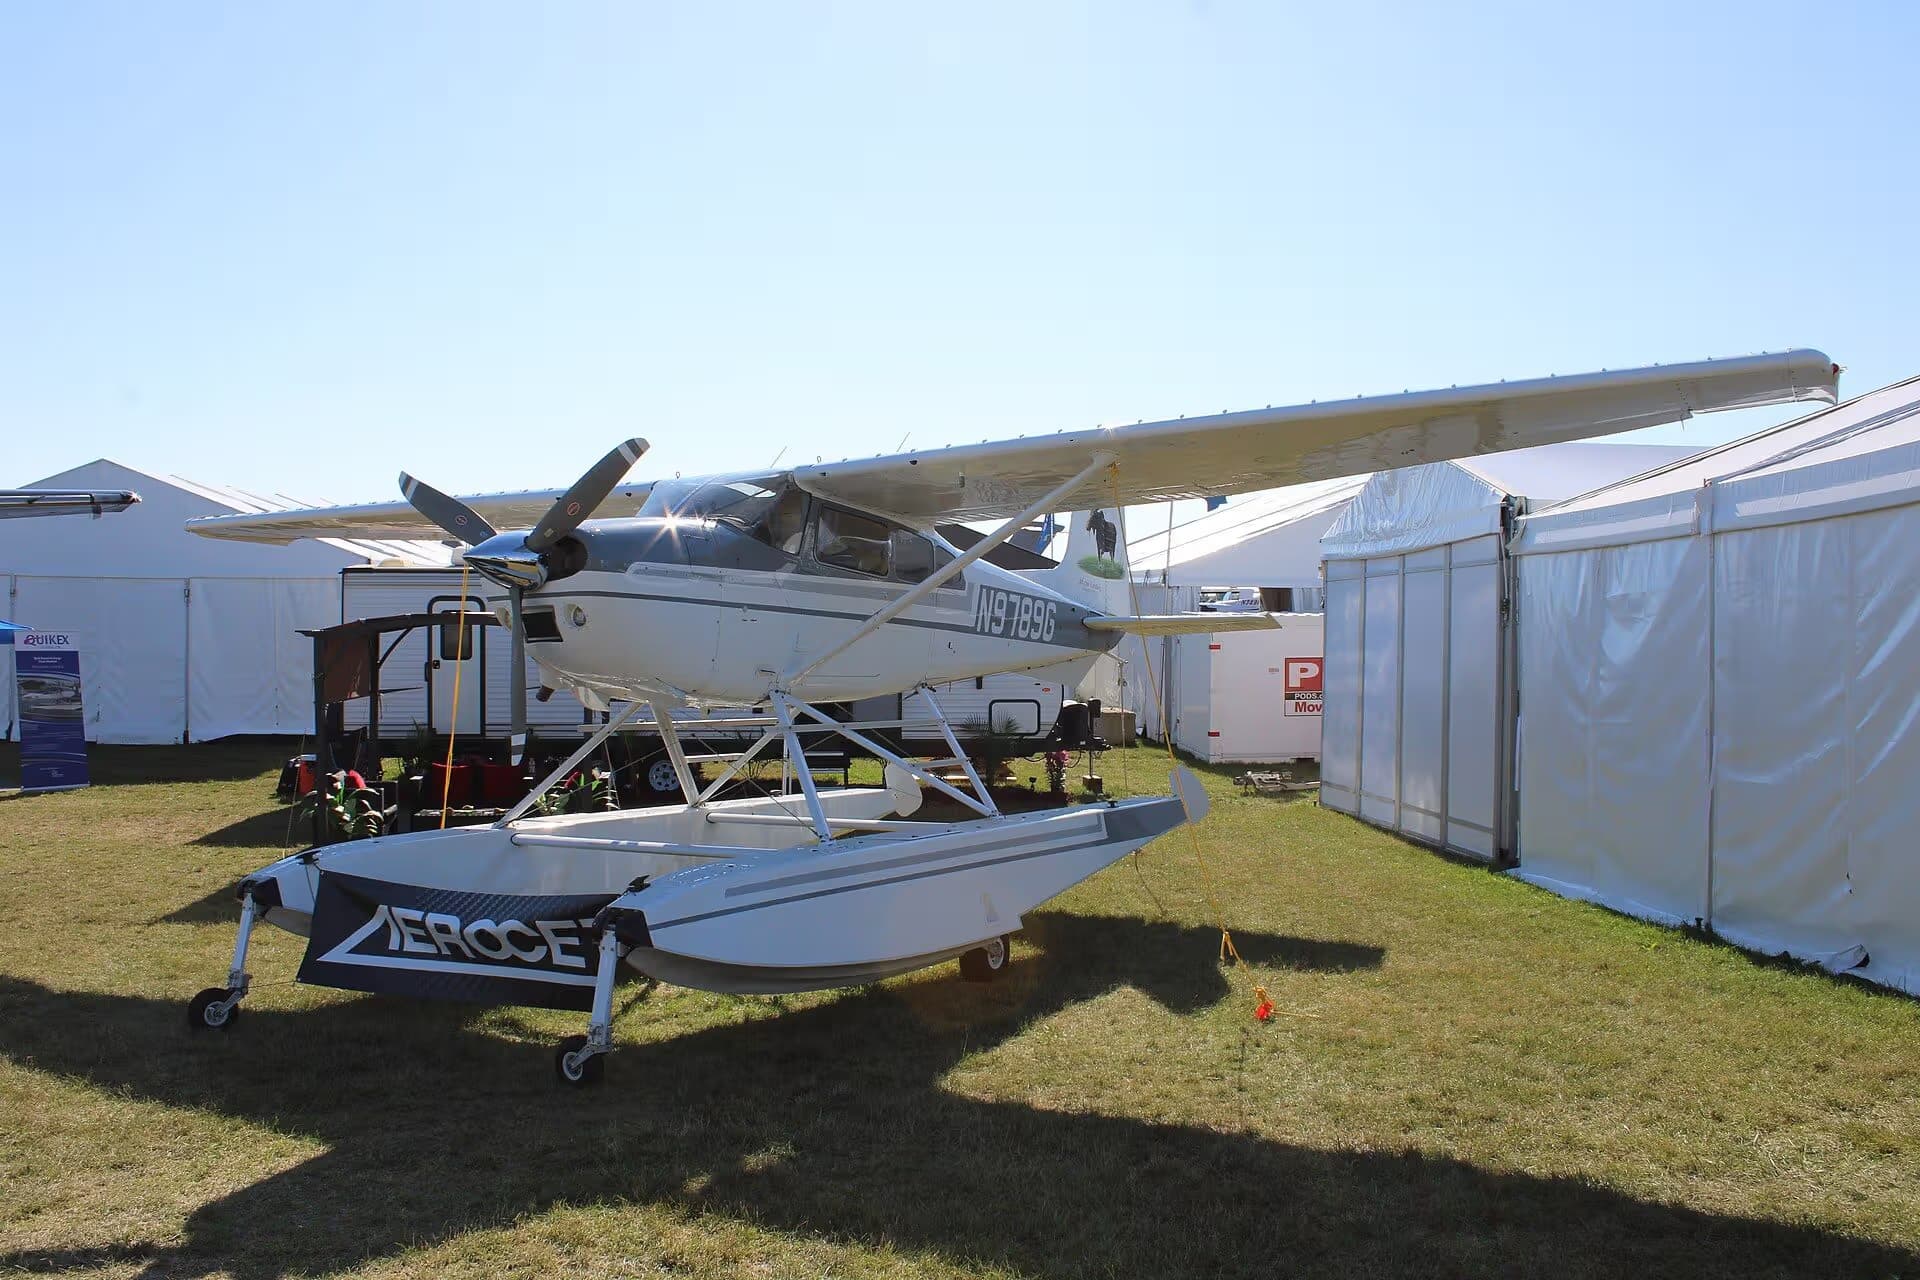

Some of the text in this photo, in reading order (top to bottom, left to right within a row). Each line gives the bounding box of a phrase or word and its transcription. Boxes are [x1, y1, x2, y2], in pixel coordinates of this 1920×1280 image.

[24, 634, 70, 646] QUIKEX
[976, 588, 1057, 642] N9789G
[316, 904, 594, 970] AEROCE
